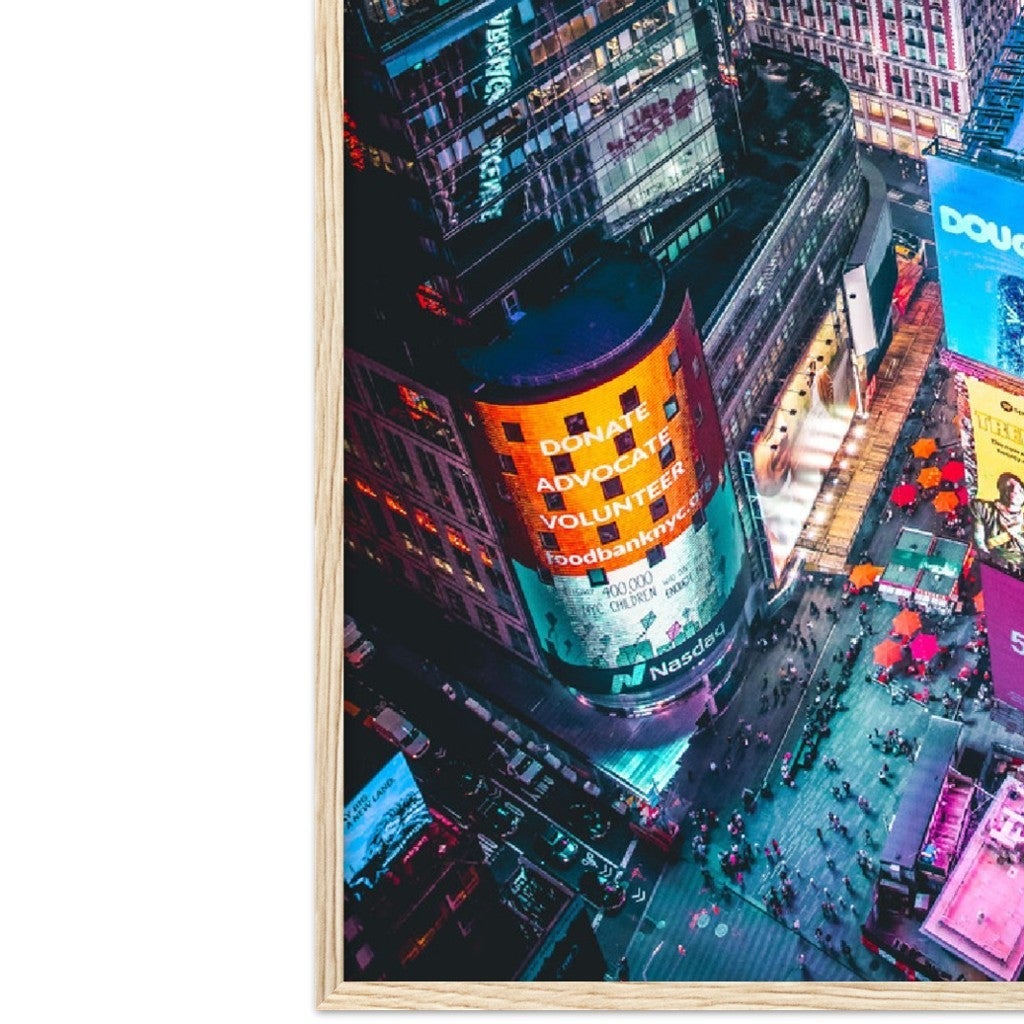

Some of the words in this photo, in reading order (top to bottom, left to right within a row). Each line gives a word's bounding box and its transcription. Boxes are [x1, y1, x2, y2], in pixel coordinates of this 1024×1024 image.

[536, 426, 672, 493] ADVOCATE
[540, 401, 650, 457] DONATE
[539, 461, 686, 530] VOLUNTEER
[650, 621, 726, 682] Nasdaq
